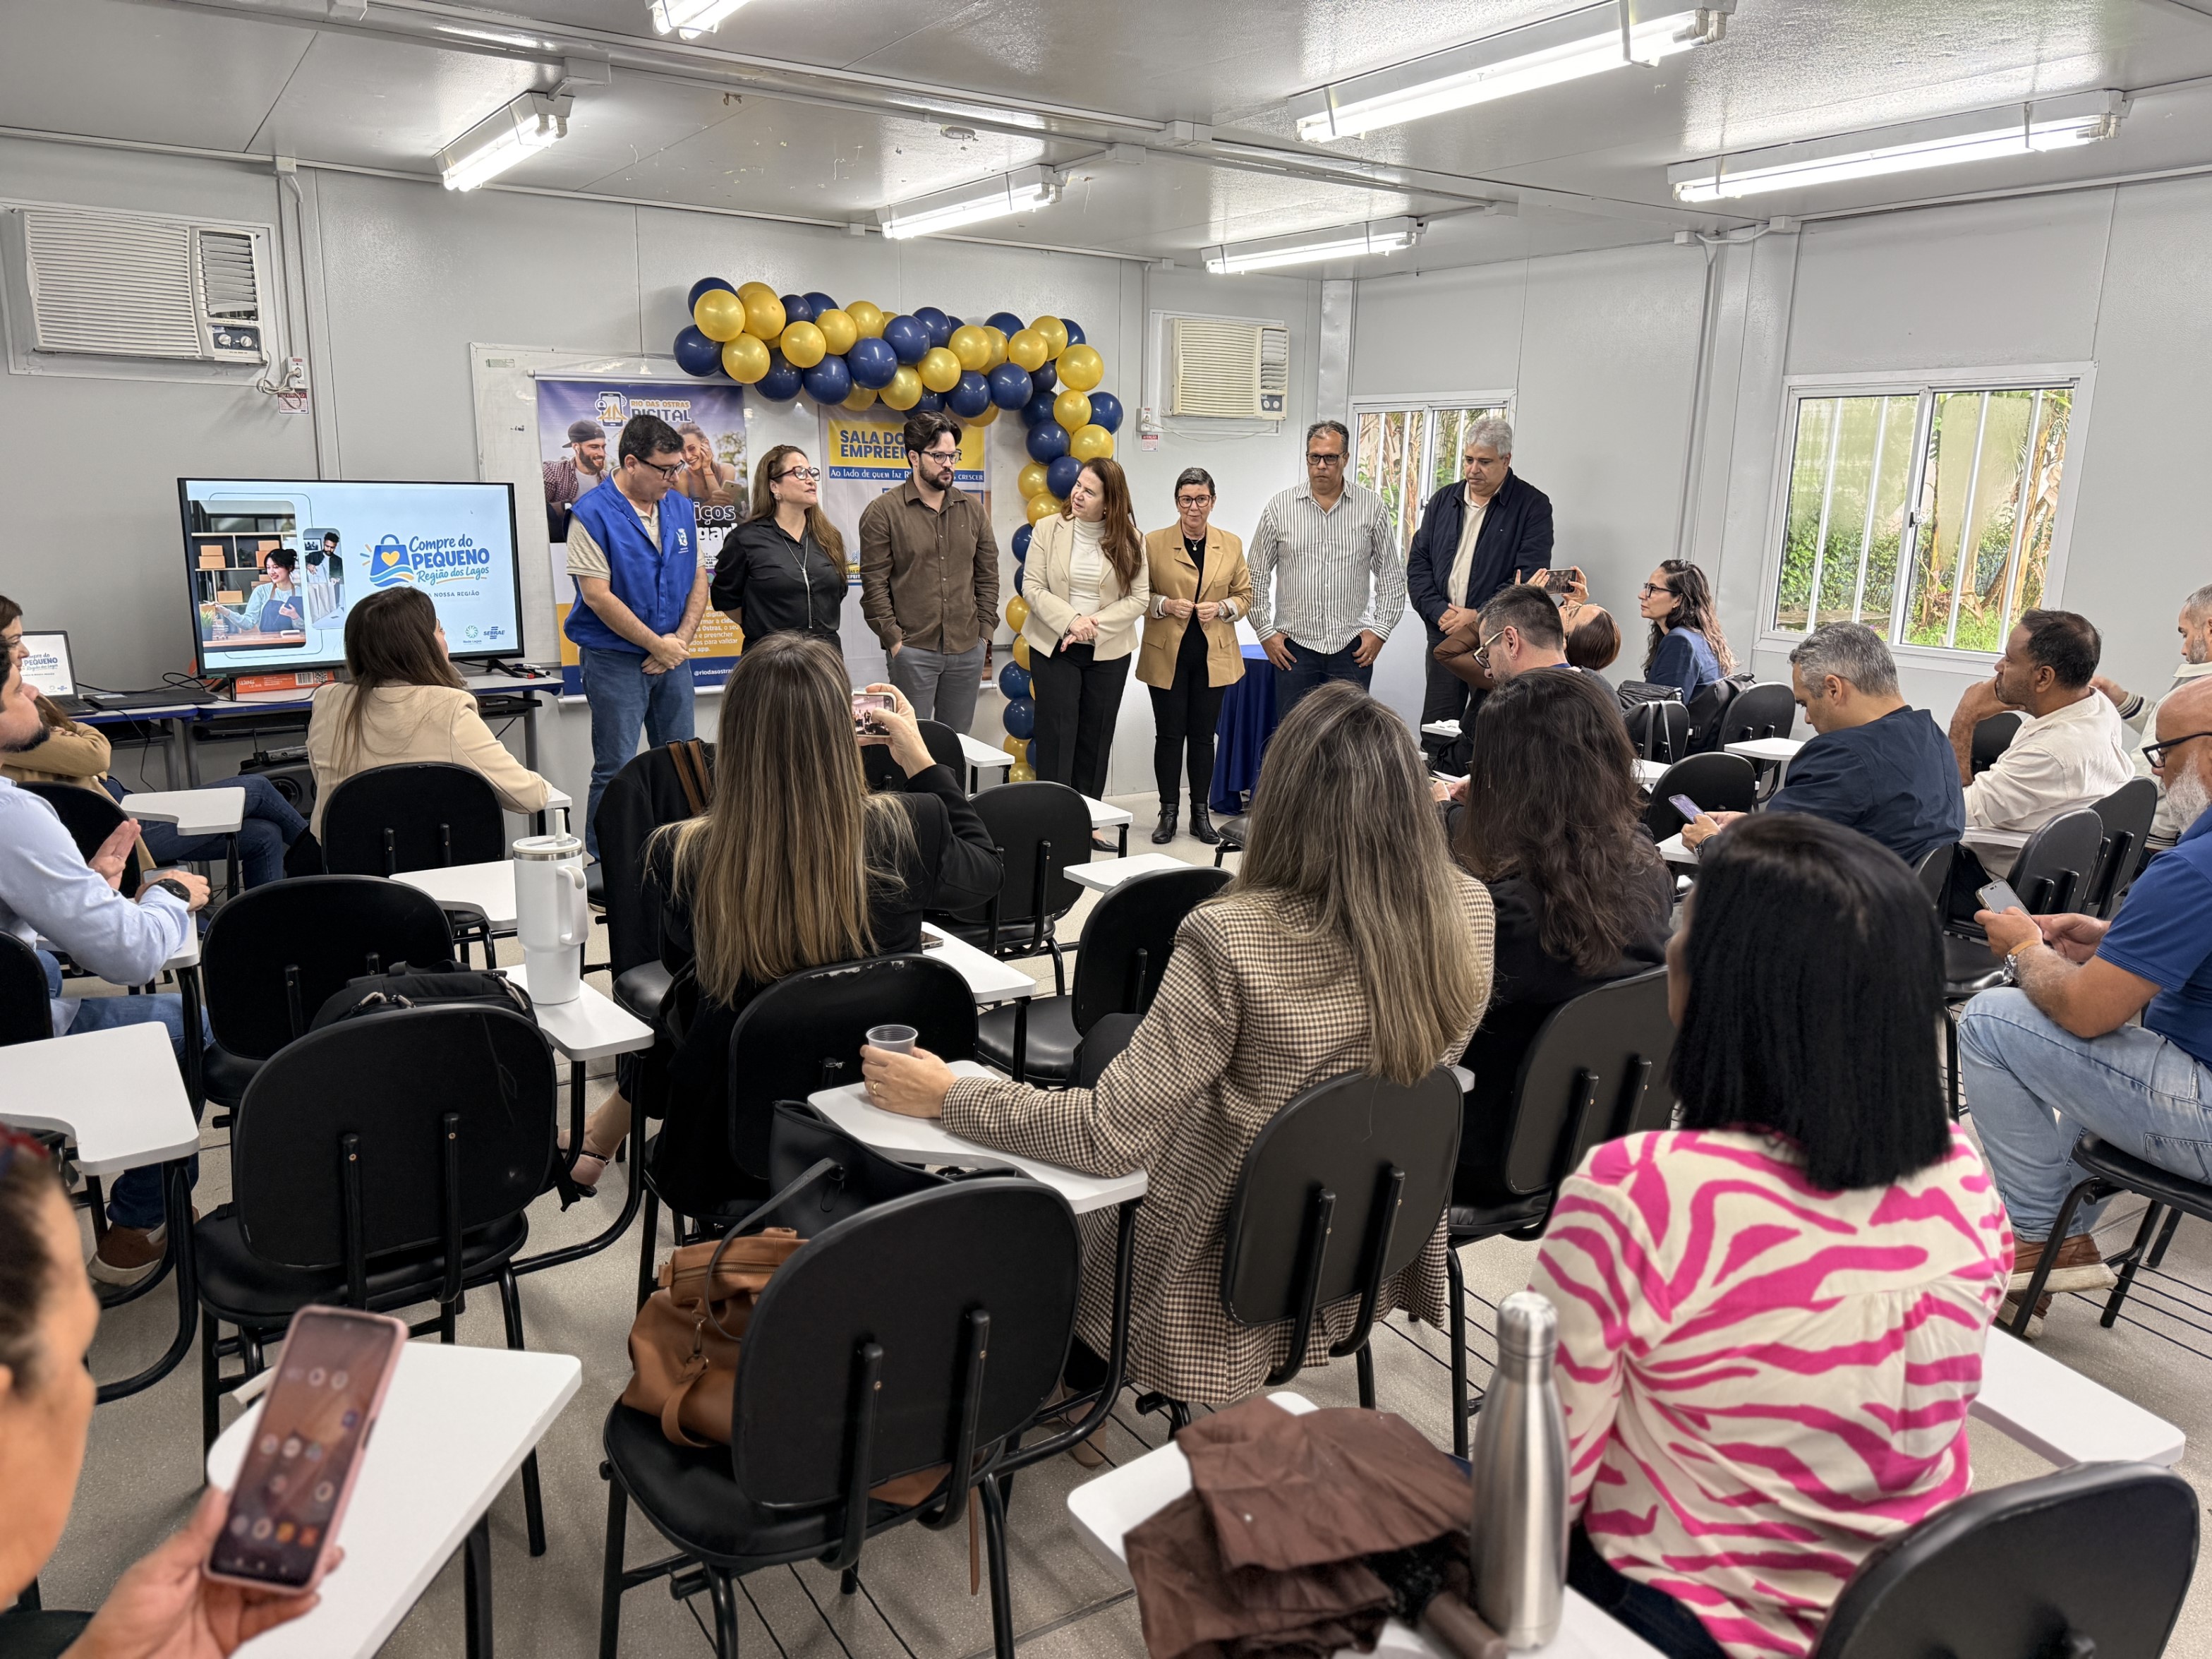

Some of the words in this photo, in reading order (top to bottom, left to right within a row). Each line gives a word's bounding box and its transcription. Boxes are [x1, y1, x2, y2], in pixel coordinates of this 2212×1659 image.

[840, 430, 880, 445] SALA
[883, 432, 905, 445] DO
[694, 502, 736, 525] iços
[409, 536, 456, 553] Compre
[458, 533, 473, 548] do
[411, 548, 490, 570] PEQUENO
[416, 569, 449, 586] Região
[450, 567, 464, 577] dos
[466, 567, 490, 581] Lagos
[24, 658, 58, 666] PEQUENO
